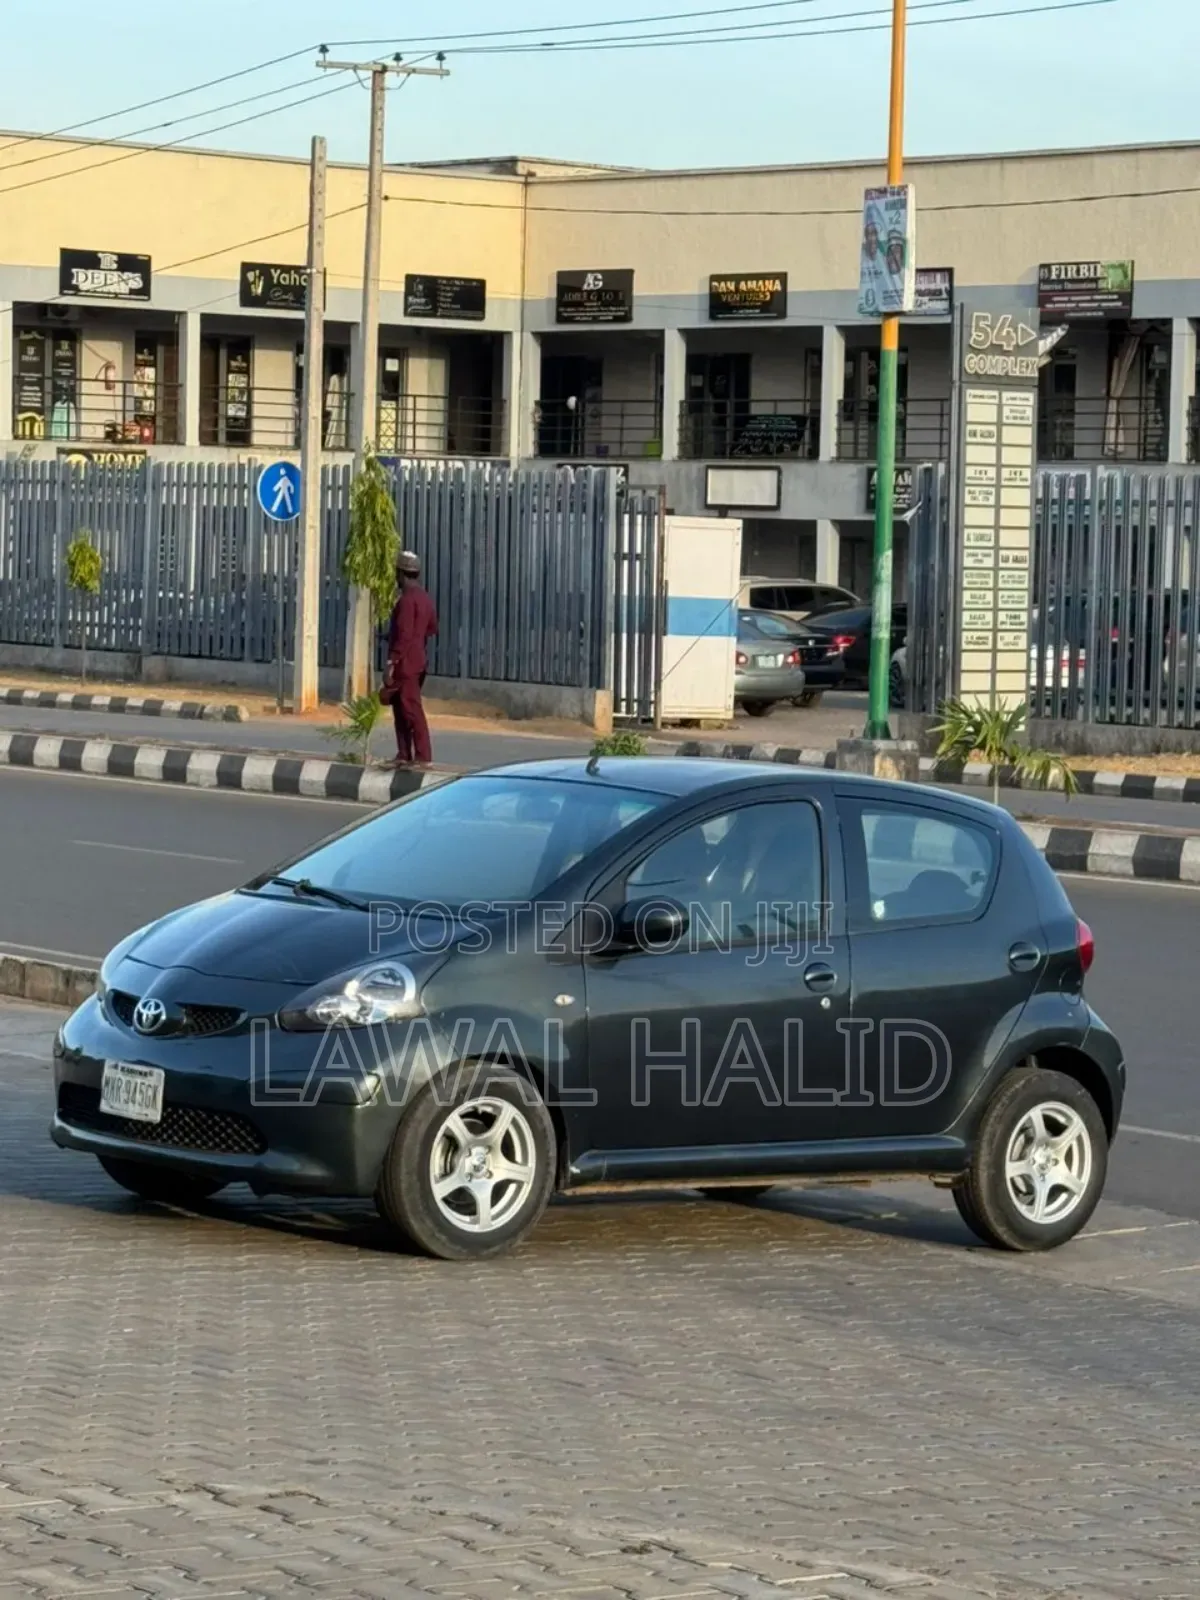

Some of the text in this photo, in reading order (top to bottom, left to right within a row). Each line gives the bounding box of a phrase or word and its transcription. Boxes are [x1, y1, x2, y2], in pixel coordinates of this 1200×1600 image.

[711, 279, 782, 293] DAN AMANA
[969, 312, 1017, 351] 54
[964, 353, 1039, 377] COMPLEX
